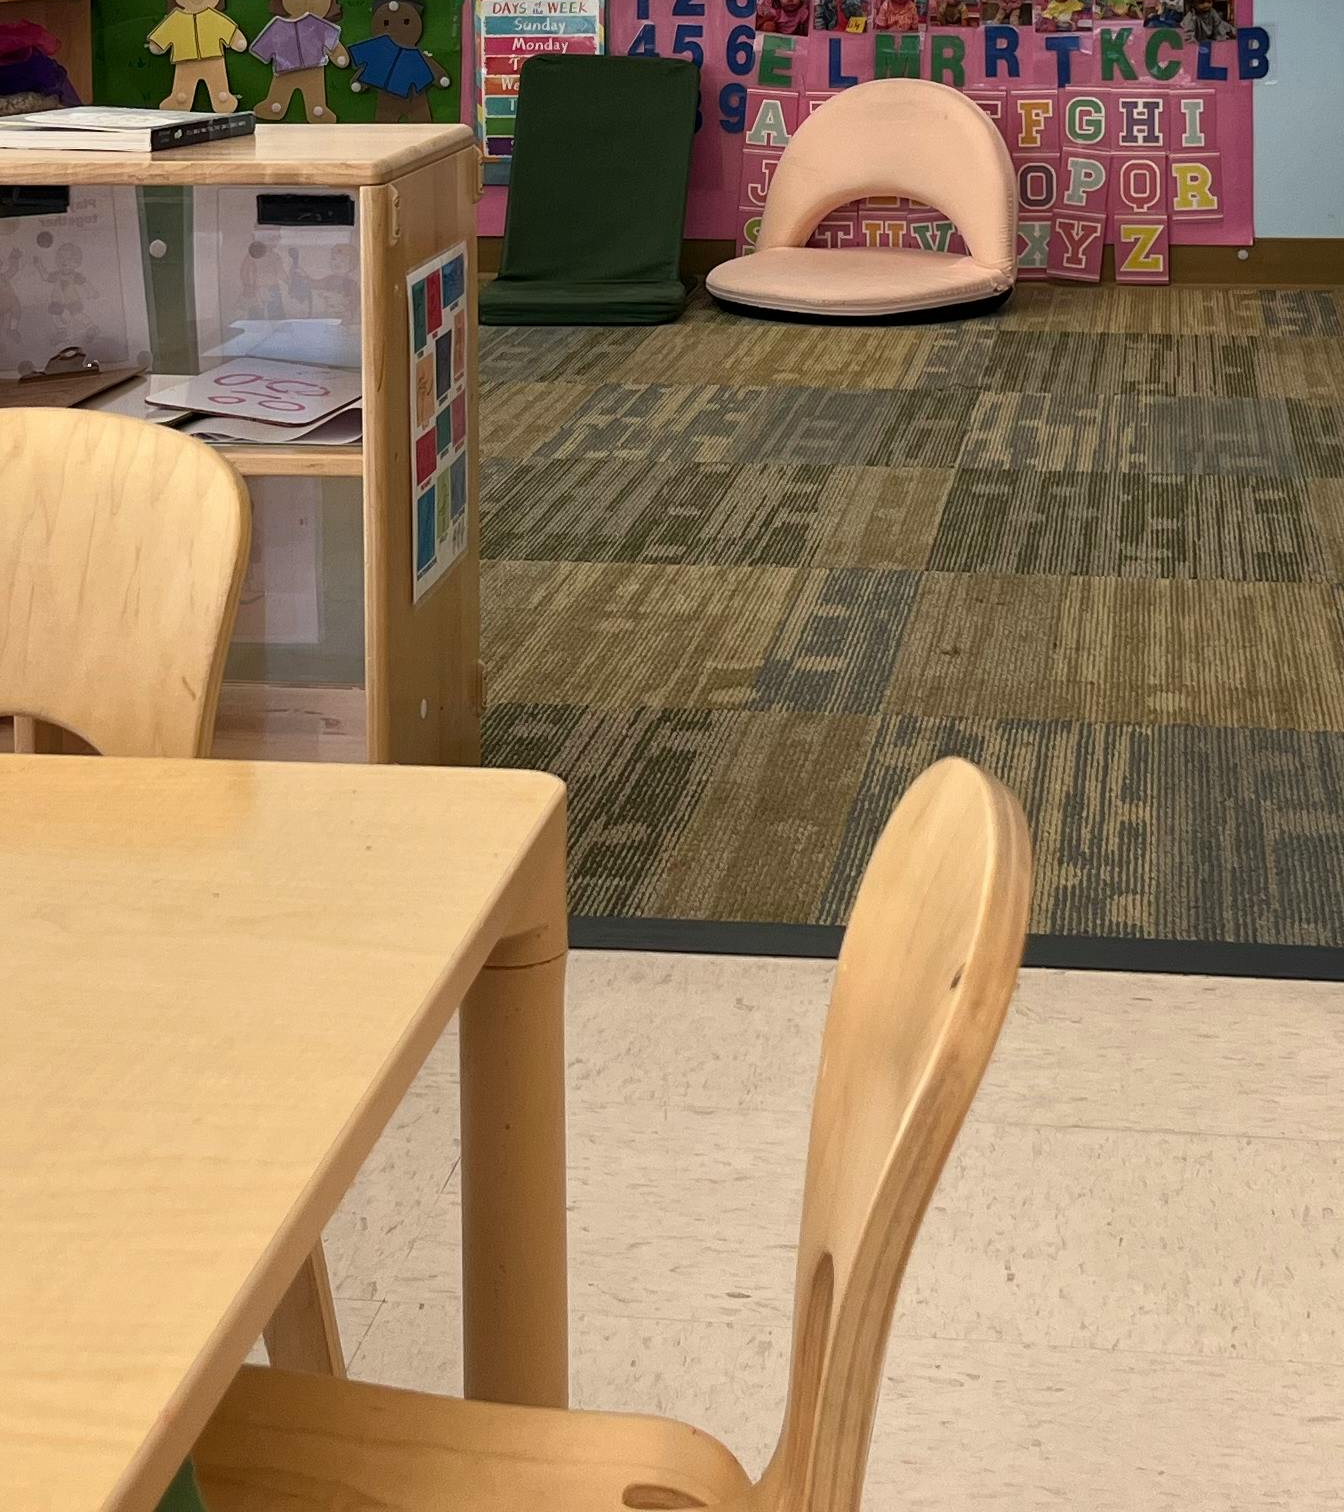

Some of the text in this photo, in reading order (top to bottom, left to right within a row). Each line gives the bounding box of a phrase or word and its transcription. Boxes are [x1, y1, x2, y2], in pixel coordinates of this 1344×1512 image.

[493, 2, 527, 14] DAYS
[548, 2, 588, 14] WEEK
[515, 18, 566, 32] Sunday
[512, 38, 568, 54] Monday
[628, 24, 756, 75] 4 5 6
[759, 26, 1269, 88] E L M R R T K C L B
[719, 83, 747, 134] 9
[746, 97, 1204, 147] A F G H I
[1018, 163, 1056, 210] O
[1064, 158, 1105, 206] P
[1120, 160, 1160, 212] Q
[1172, 163, 1217, 210] R
[1018, 221, 1051, 269] X
[1056, 219, 1101, 268] Y
[1120, 225, 1163, 271] Z
